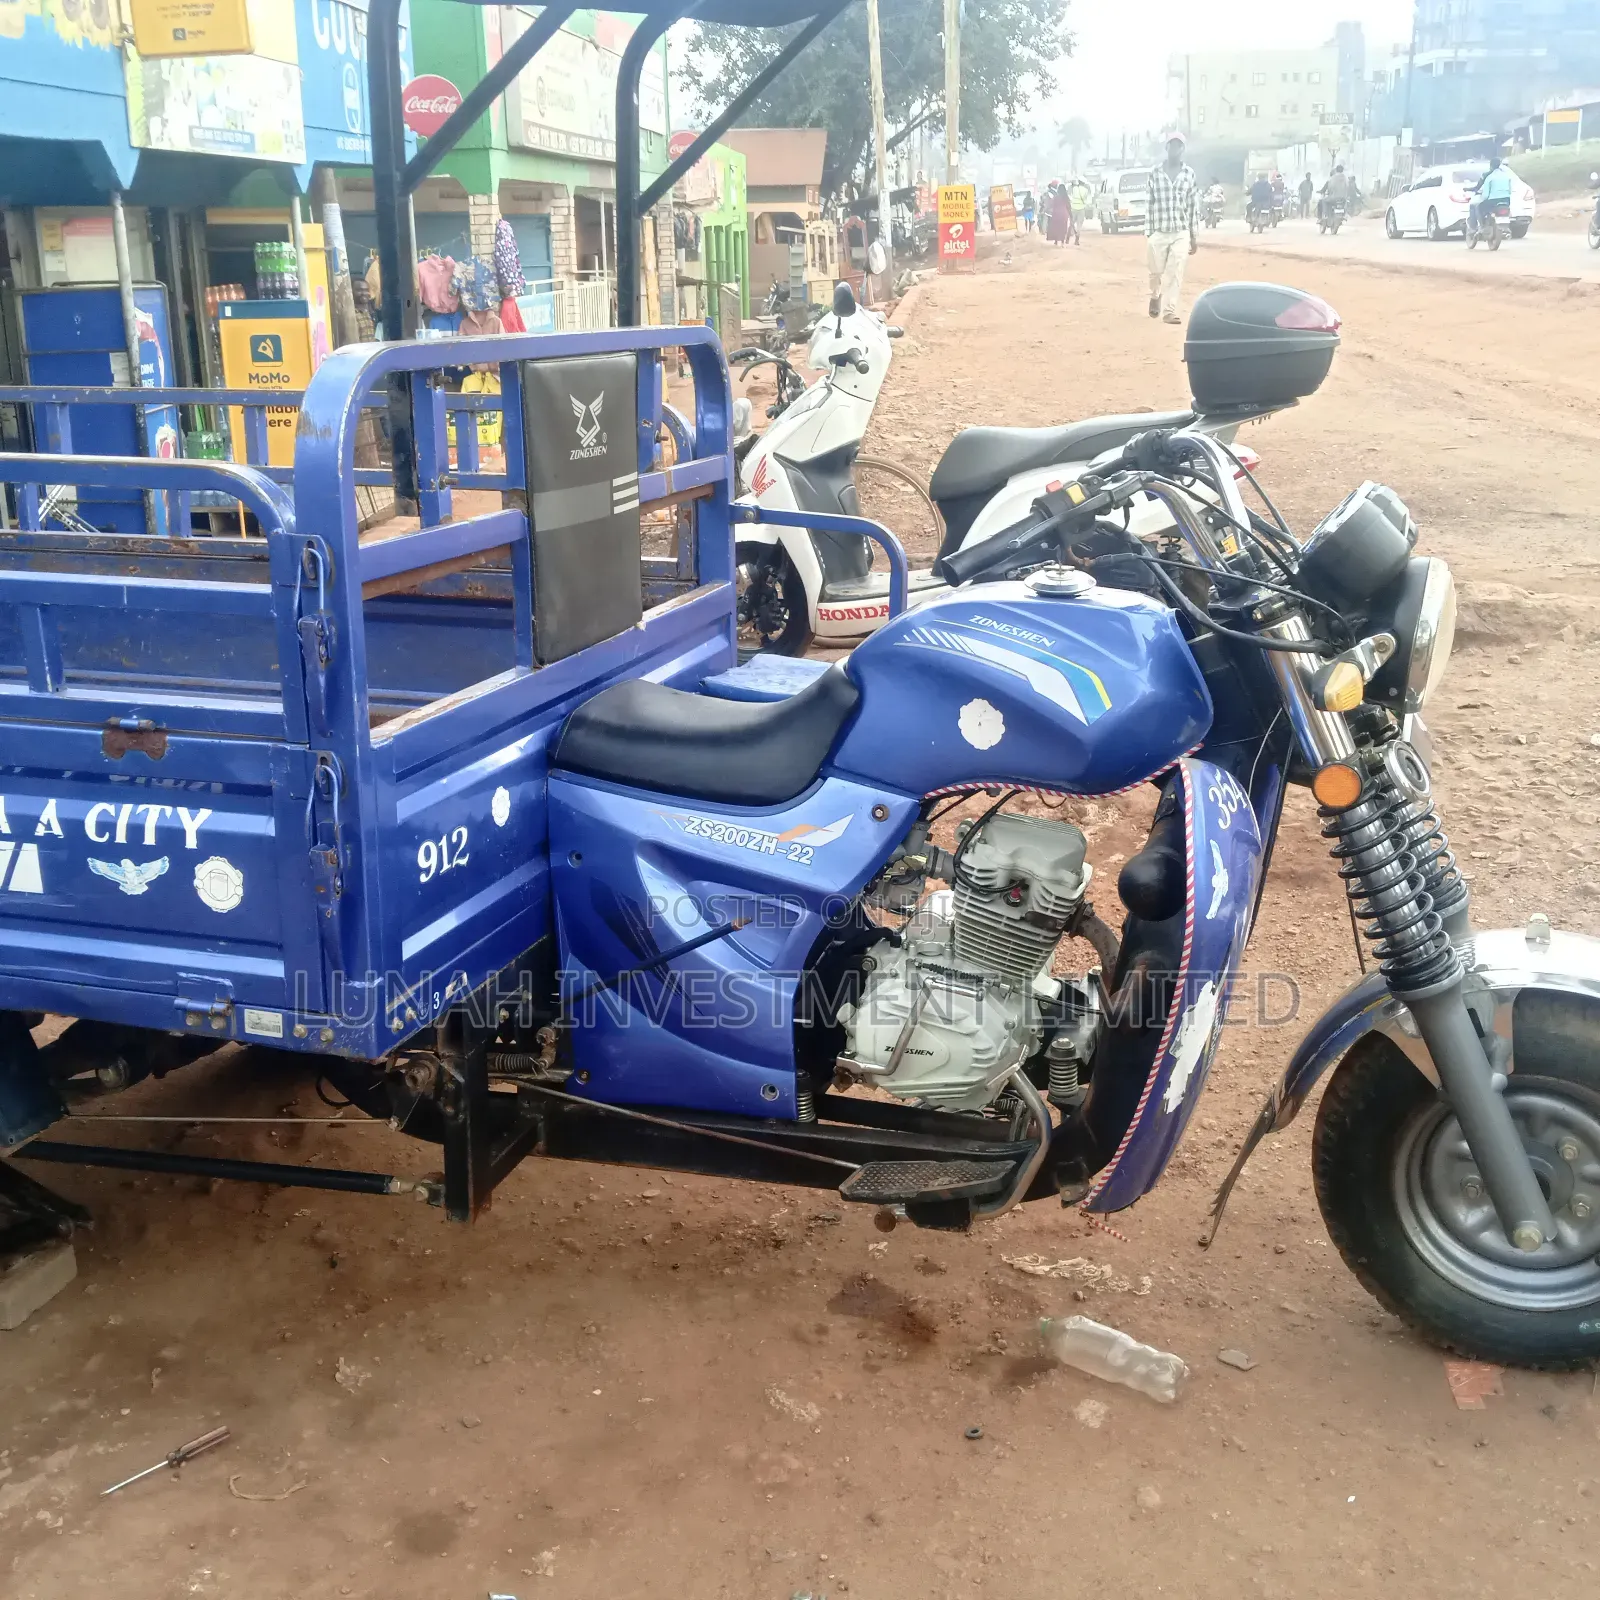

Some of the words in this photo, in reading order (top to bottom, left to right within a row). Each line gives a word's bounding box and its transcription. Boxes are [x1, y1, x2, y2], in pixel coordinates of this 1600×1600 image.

[944, 191, 968, 201] MTN
[943, 239, 971, 249] airtel
[248, 372, 291, 384] MoMo
[265, 418, 292, 428] ere
[569, 445, 608, 461] ZONGSHEN
[817, 604, 890, 621] HONDA
[968, 614, 1057, 648] ZONGSHEN
[1208, 768, 1248, 830] 354
[84, 801, 213, 849] CITY
[683, 815, 815, 866] ZS200ZH-22
[417, 825, 470, 884] 912
